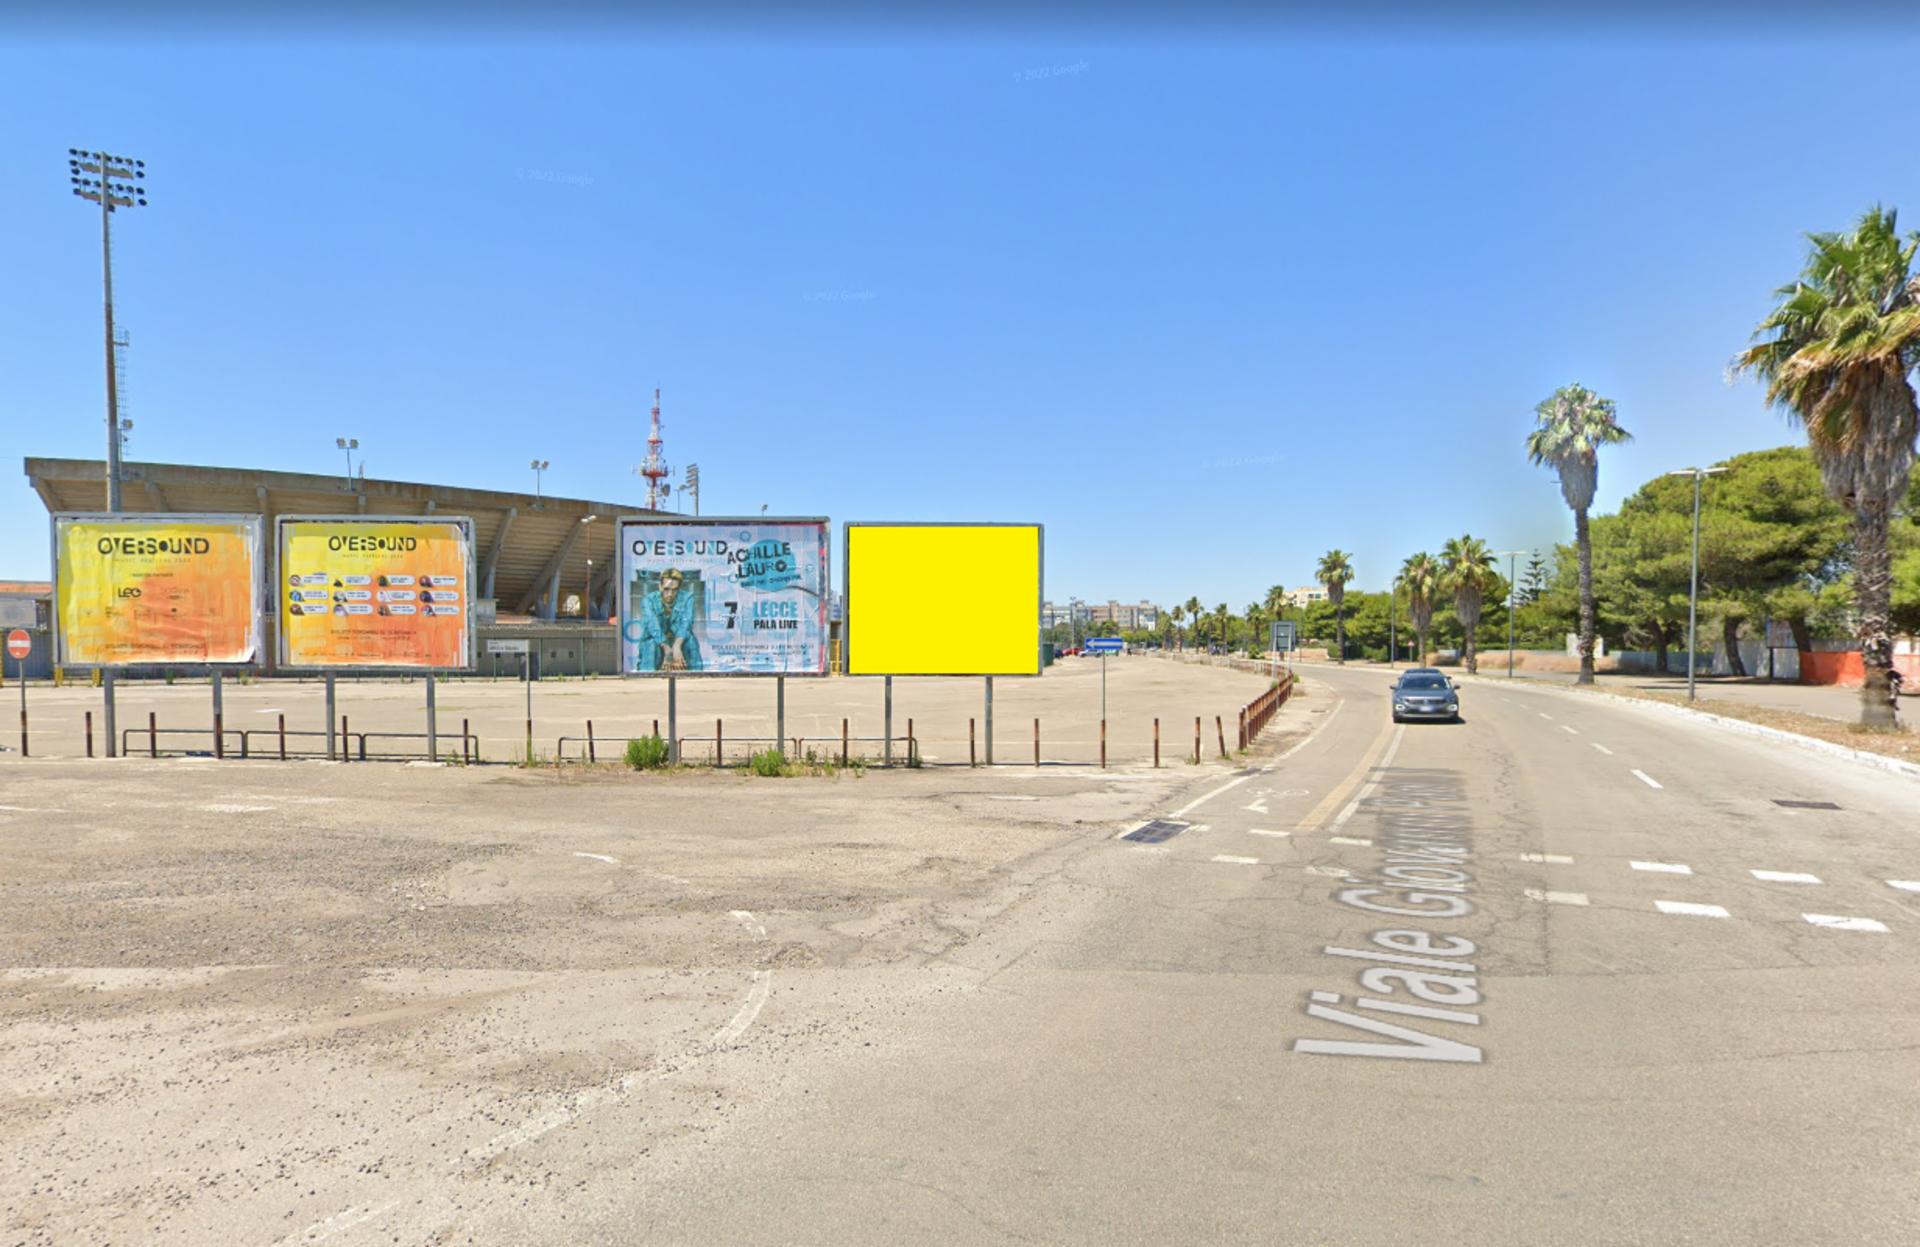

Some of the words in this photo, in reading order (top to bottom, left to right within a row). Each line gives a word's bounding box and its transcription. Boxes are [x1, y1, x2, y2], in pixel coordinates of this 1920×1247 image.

[727, 541, 791, 564] ACHILLE
[737, 559, 788, 578] LAURO
[753, 601, 798, 618] LECCE
[754, 619, 777, 630] PALA
[779, 619, 798, 630] LIVE
